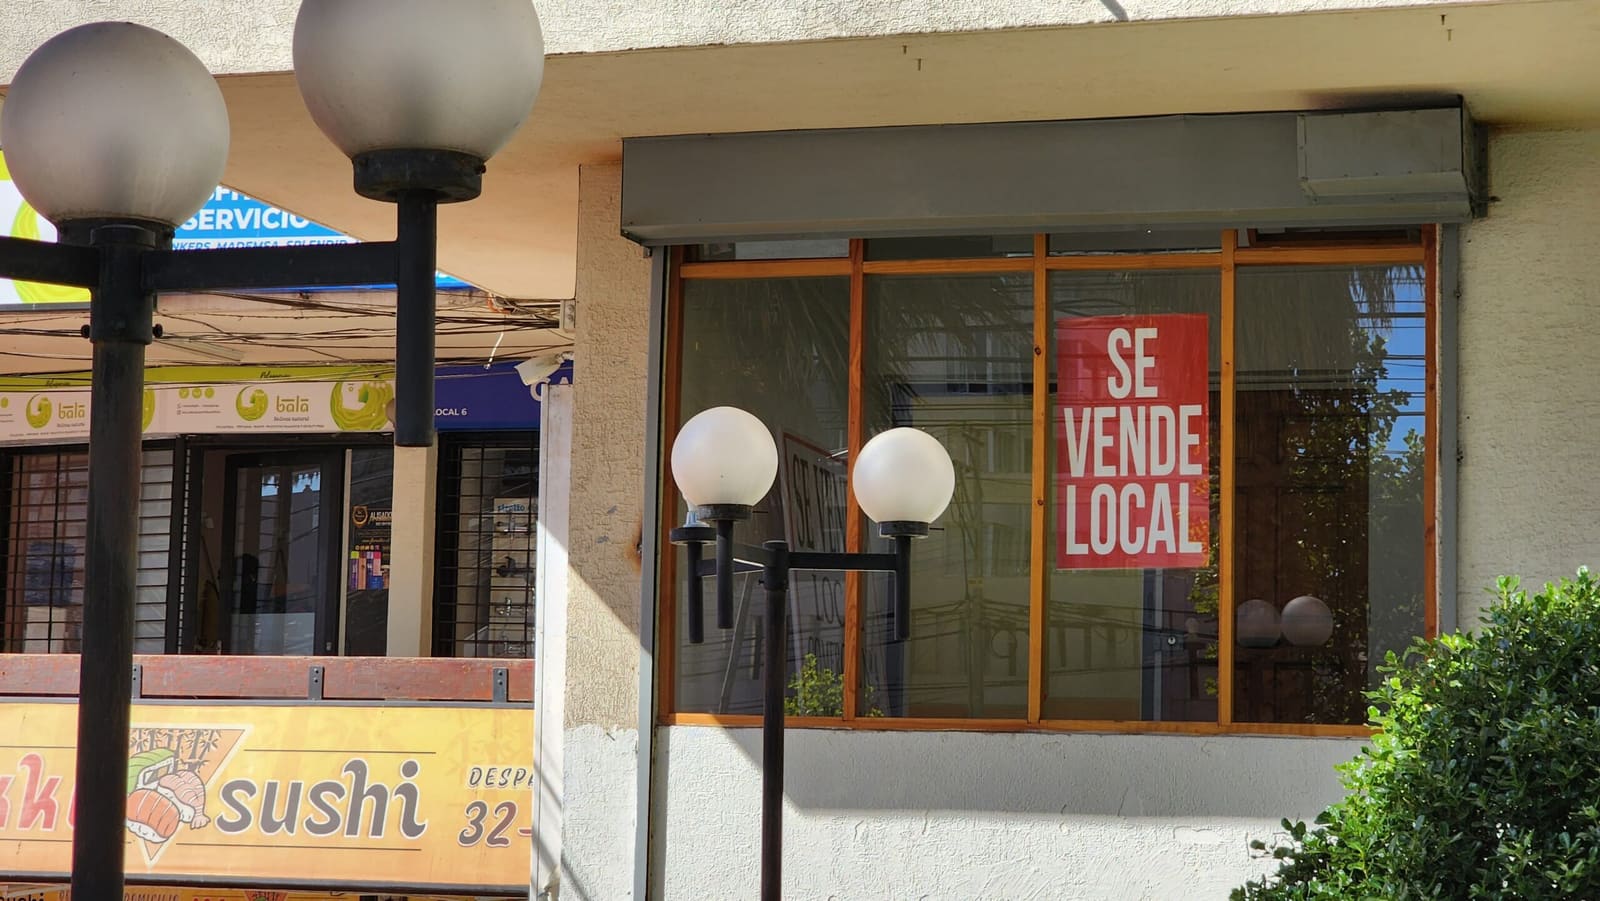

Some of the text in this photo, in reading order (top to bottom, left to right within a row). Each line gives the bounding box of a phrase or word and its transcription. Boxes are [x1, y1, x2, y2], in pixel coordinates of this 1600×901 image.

[180, 207, 310, 231] SERVICIO
[1106, 327, 1158, 399] SE
[434, 408, 467, 416] OCAL 6
[1063, 404, 1203, 477] VENDE
[1065, 482, 1203, 556] LOCAL
[217, 759, 427, 839] sushi
